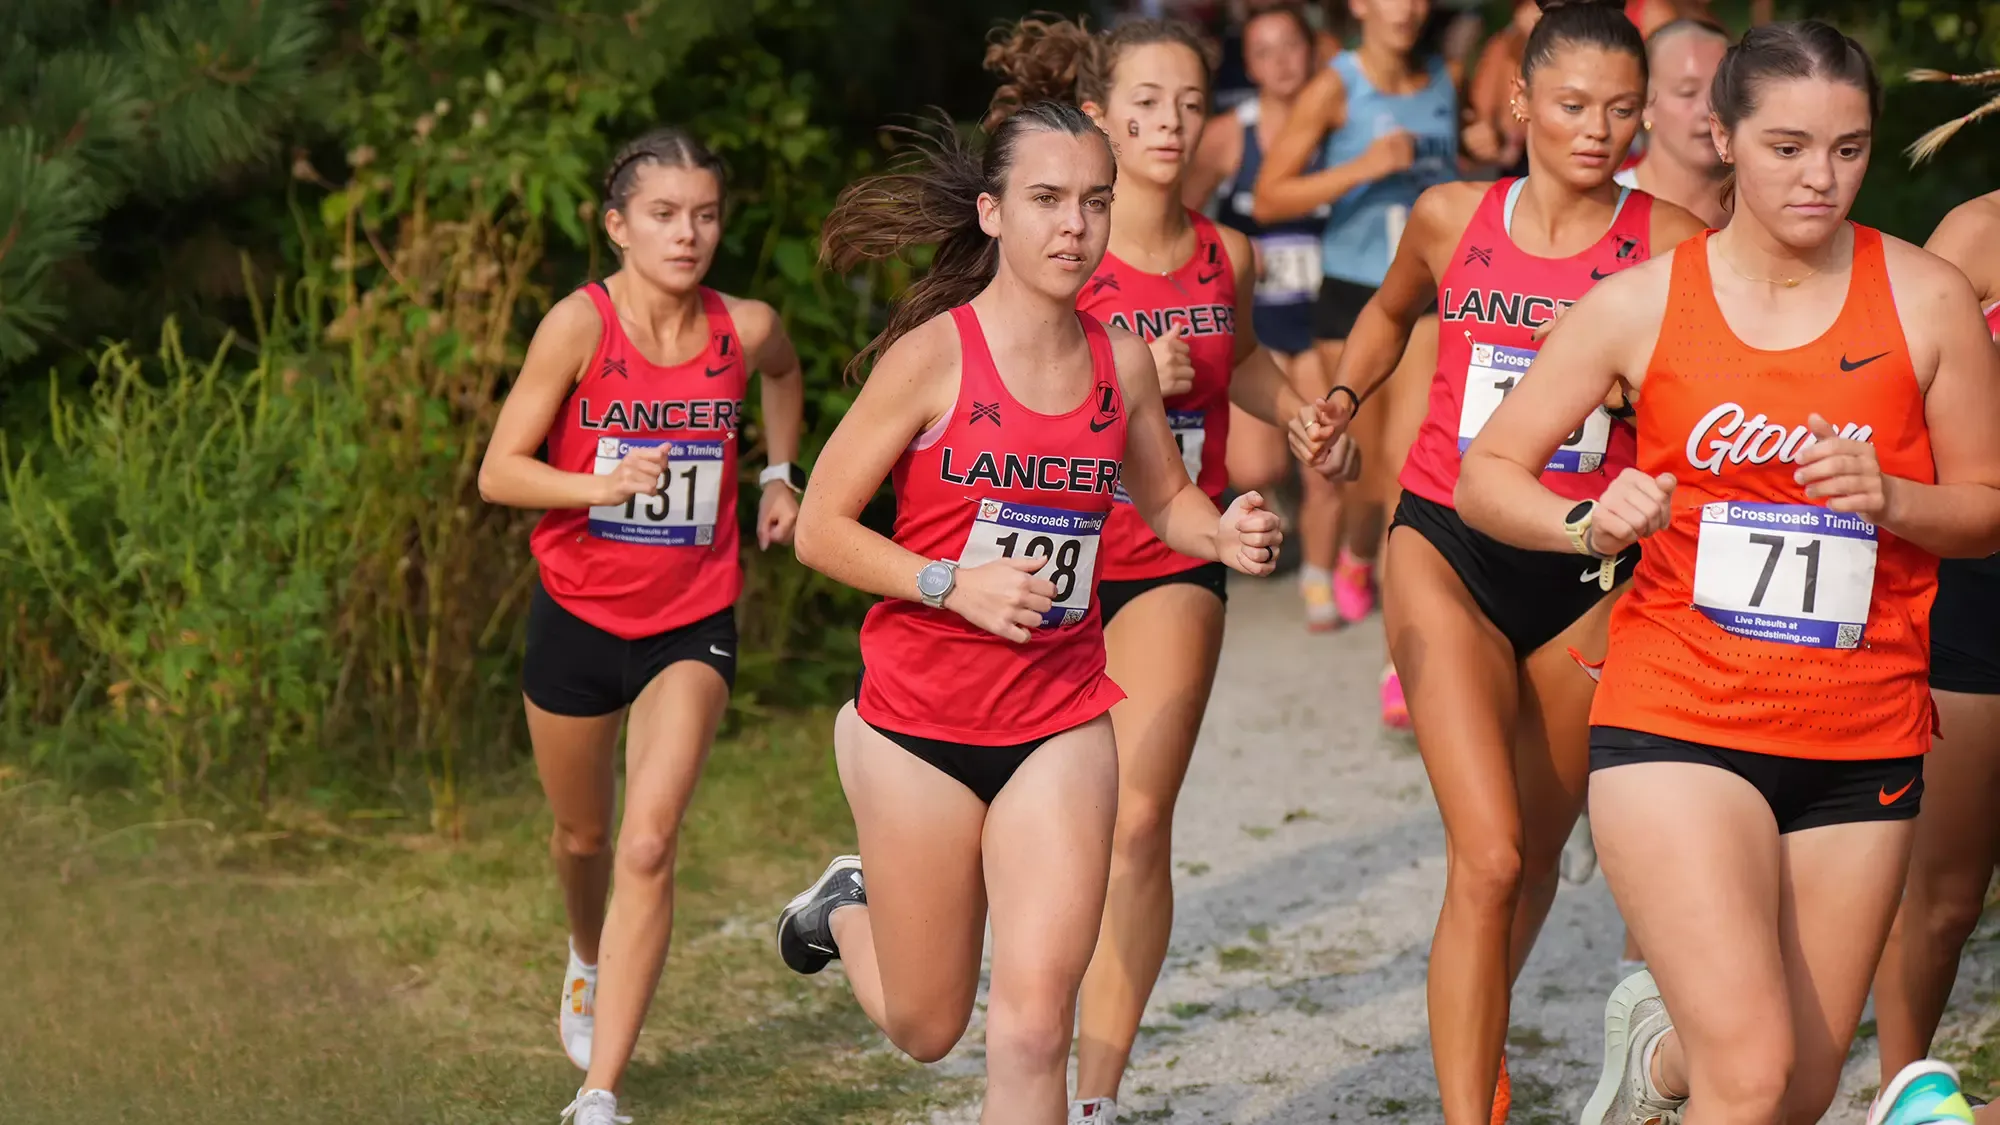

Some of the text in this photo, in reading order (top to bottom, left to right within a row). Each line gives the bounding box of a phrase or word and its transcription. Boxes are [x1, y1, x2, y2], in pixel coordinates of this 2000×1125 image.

[1443, 287, 1578, 330] LANC
[1109, 304, 1237, 342] ANCER
[1494, 351, 1535, 368] Cross
[686, 444, 723, 458] Timing
[1001, 508, 1102, 530] Crossroads Timing
[1730, 506, 1875, 535] Crossroads Timing
[1748, 532, 1821, 613] 71
[1734, 615, 1798, 630] Live Results at
